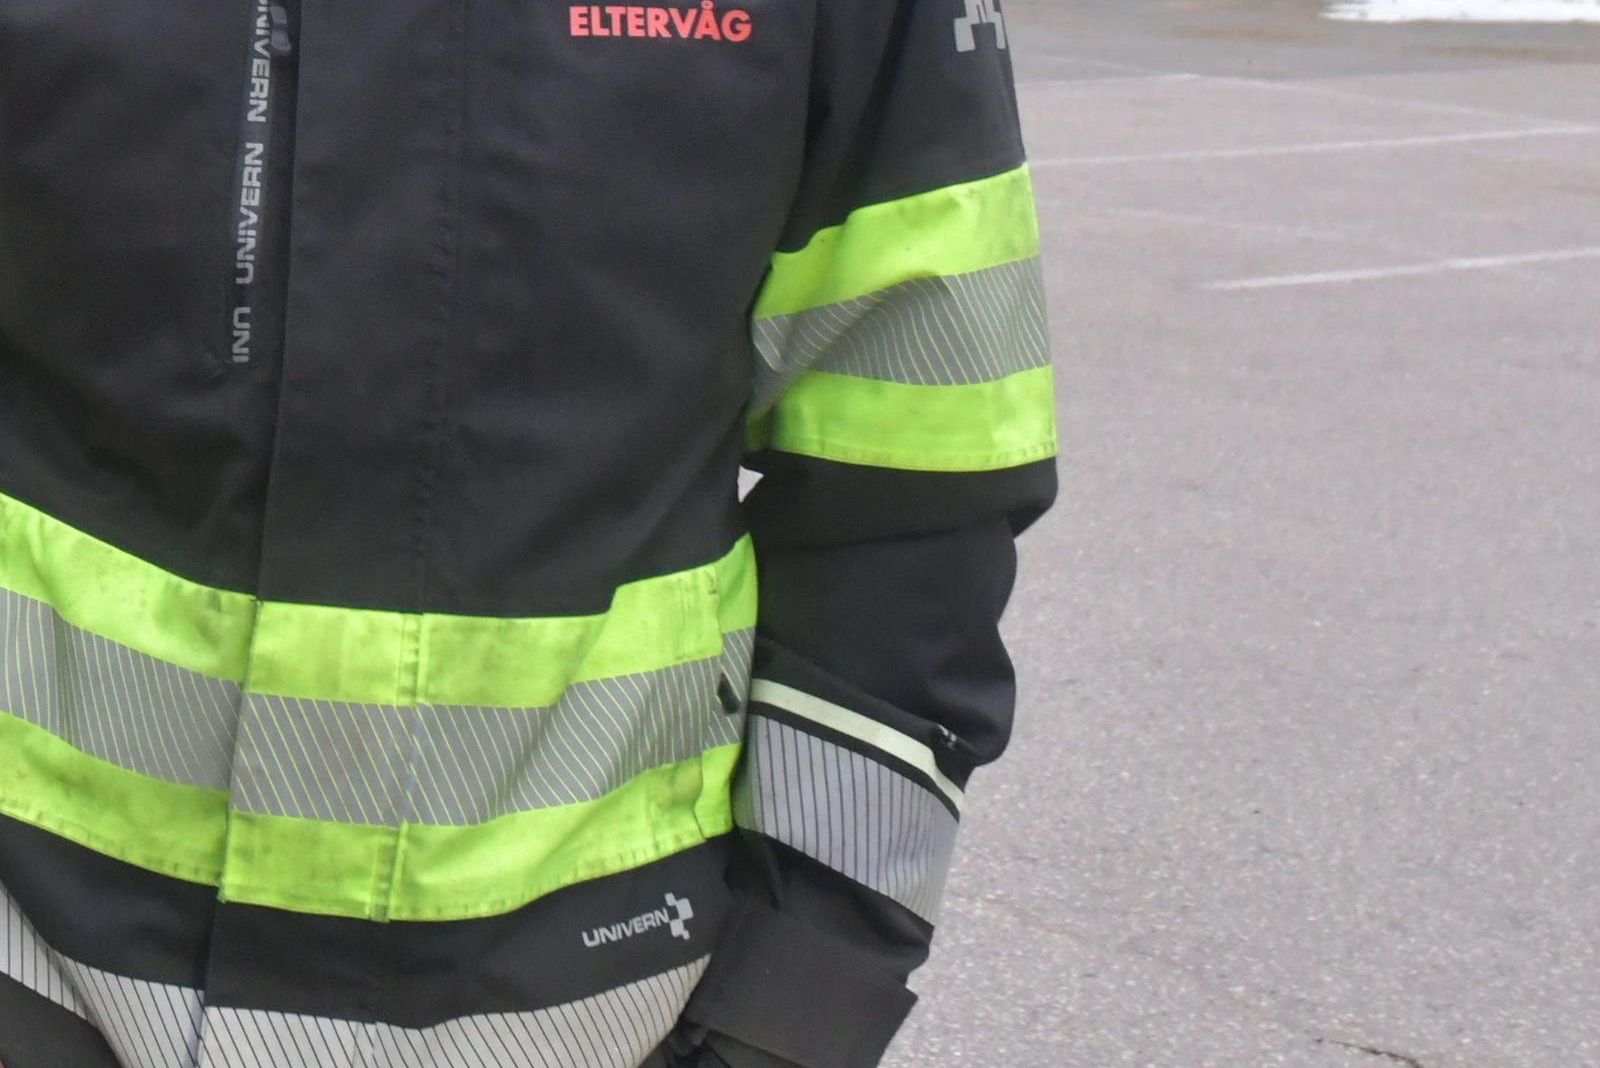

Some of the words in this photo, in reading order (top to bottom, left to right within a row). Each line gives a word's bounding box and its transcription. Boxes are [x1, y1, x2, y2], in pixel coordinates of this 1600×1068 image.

[568, 0, 752, 43] ELTERVÅG
[236, 142, 265, 285] UNIVERN
[581, 907, 670, 948] UNIVERN
